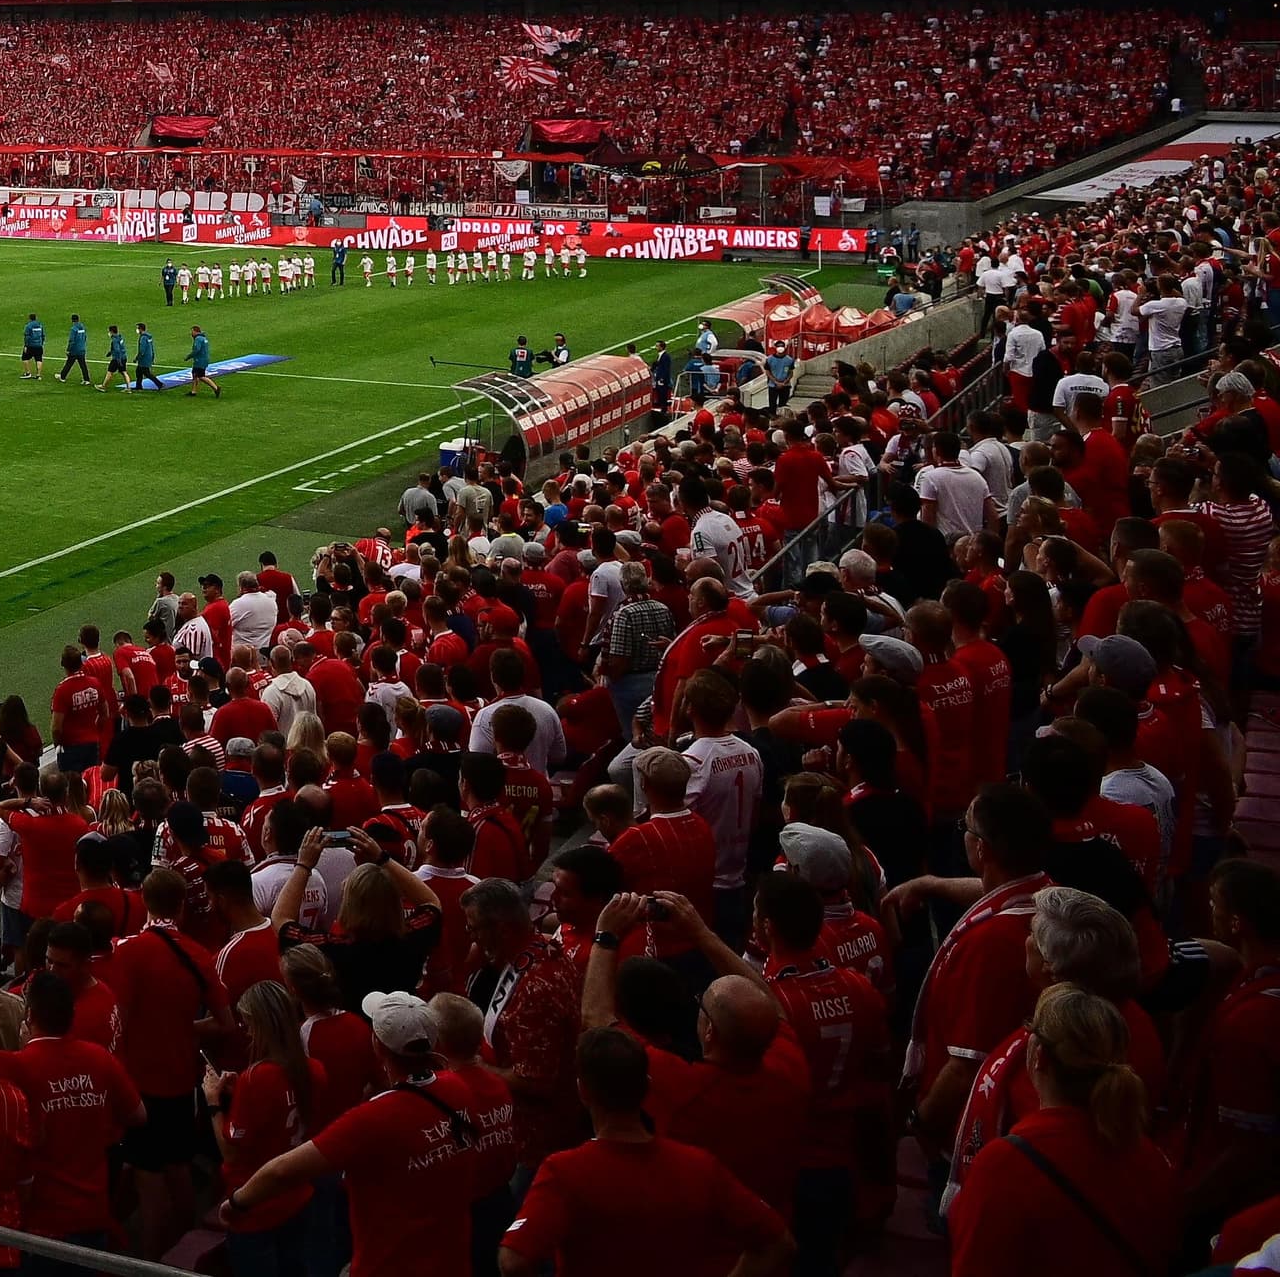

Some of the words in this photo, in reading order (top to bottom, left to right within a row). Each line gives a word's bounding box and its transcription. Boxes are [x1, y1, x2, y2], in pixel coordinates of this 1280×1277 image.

[185, 226, 196, 240] 20
[216, 224, 244, 239] MARVIN
[234, 227, 271, 244] SCHWÄBE
[733, 229, 798, 248] ANDERS
[444, 236, 456, 248] 20
[478, 234, 511, 249] MARVIN
[505, 784, 538, 798] HECTOR
[811, 996, 854, 1020] RISSE
[820, 1023, 852, 1089] 7
